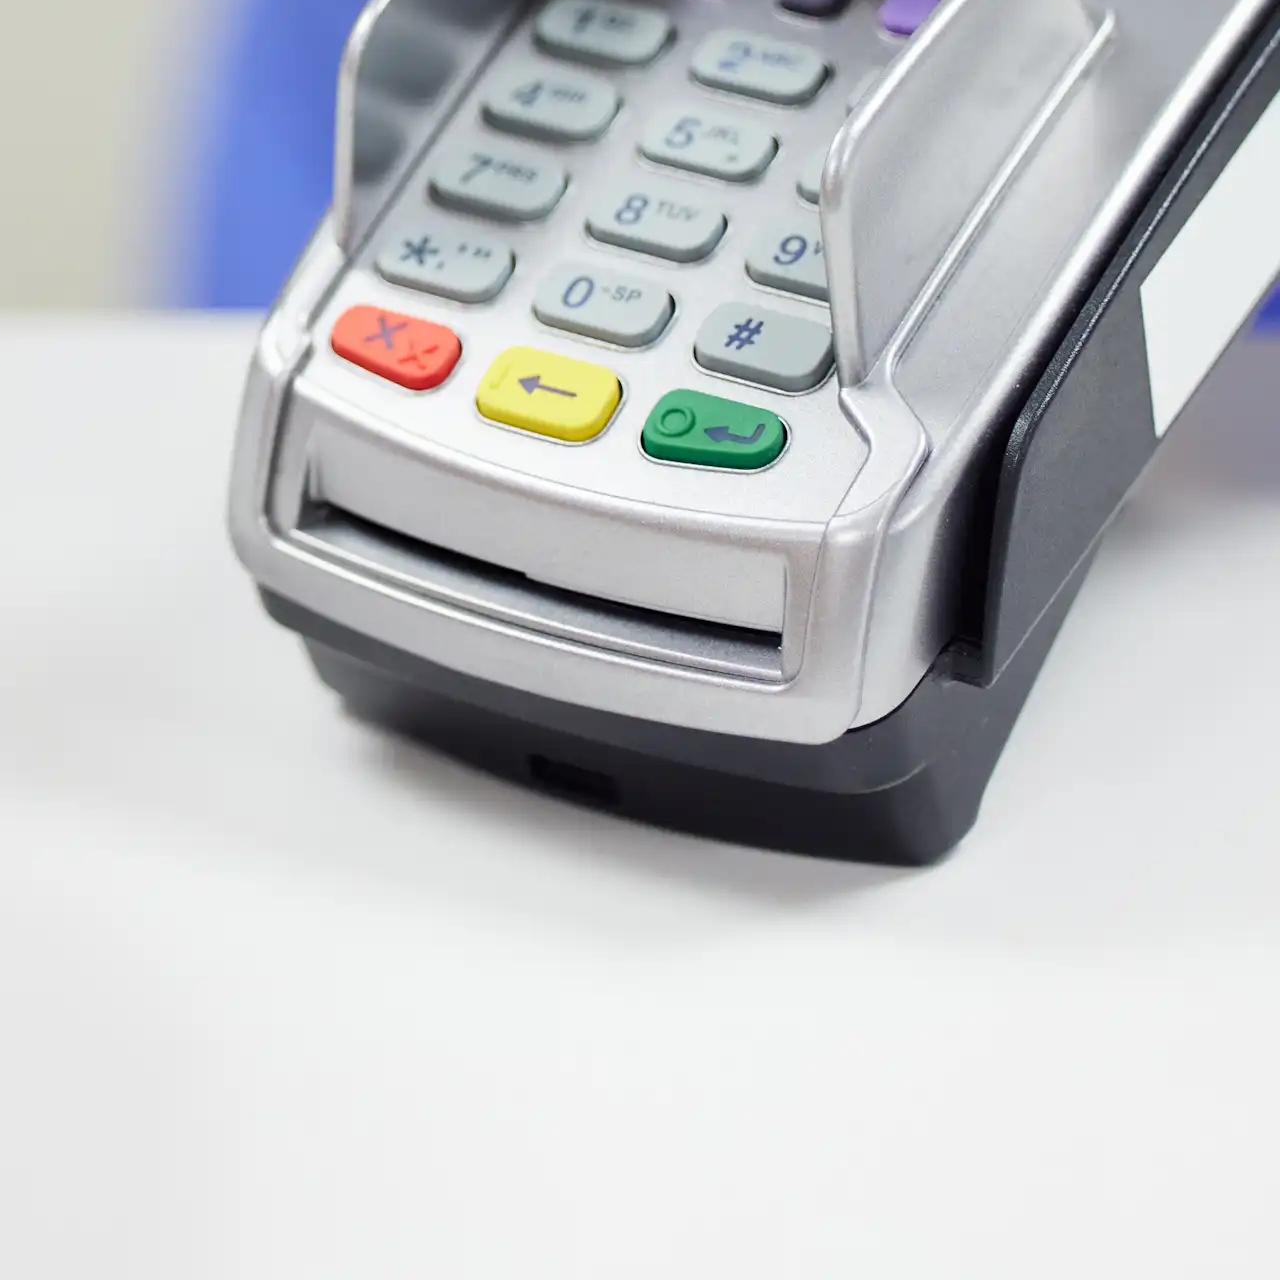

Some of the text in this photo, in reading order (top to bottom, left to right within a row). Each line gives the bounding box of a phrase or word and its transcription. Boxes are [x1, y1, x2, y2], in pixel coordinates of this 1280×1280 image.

[718, 40, 752, 70] 2
[665, 116, 701, 149] 5
[459, 152, 493, 183] 7
[615, 193, 700, 225] 8 TUV
[773, 234, 808, 266] 9
[562, 275, 595, 308] 0
